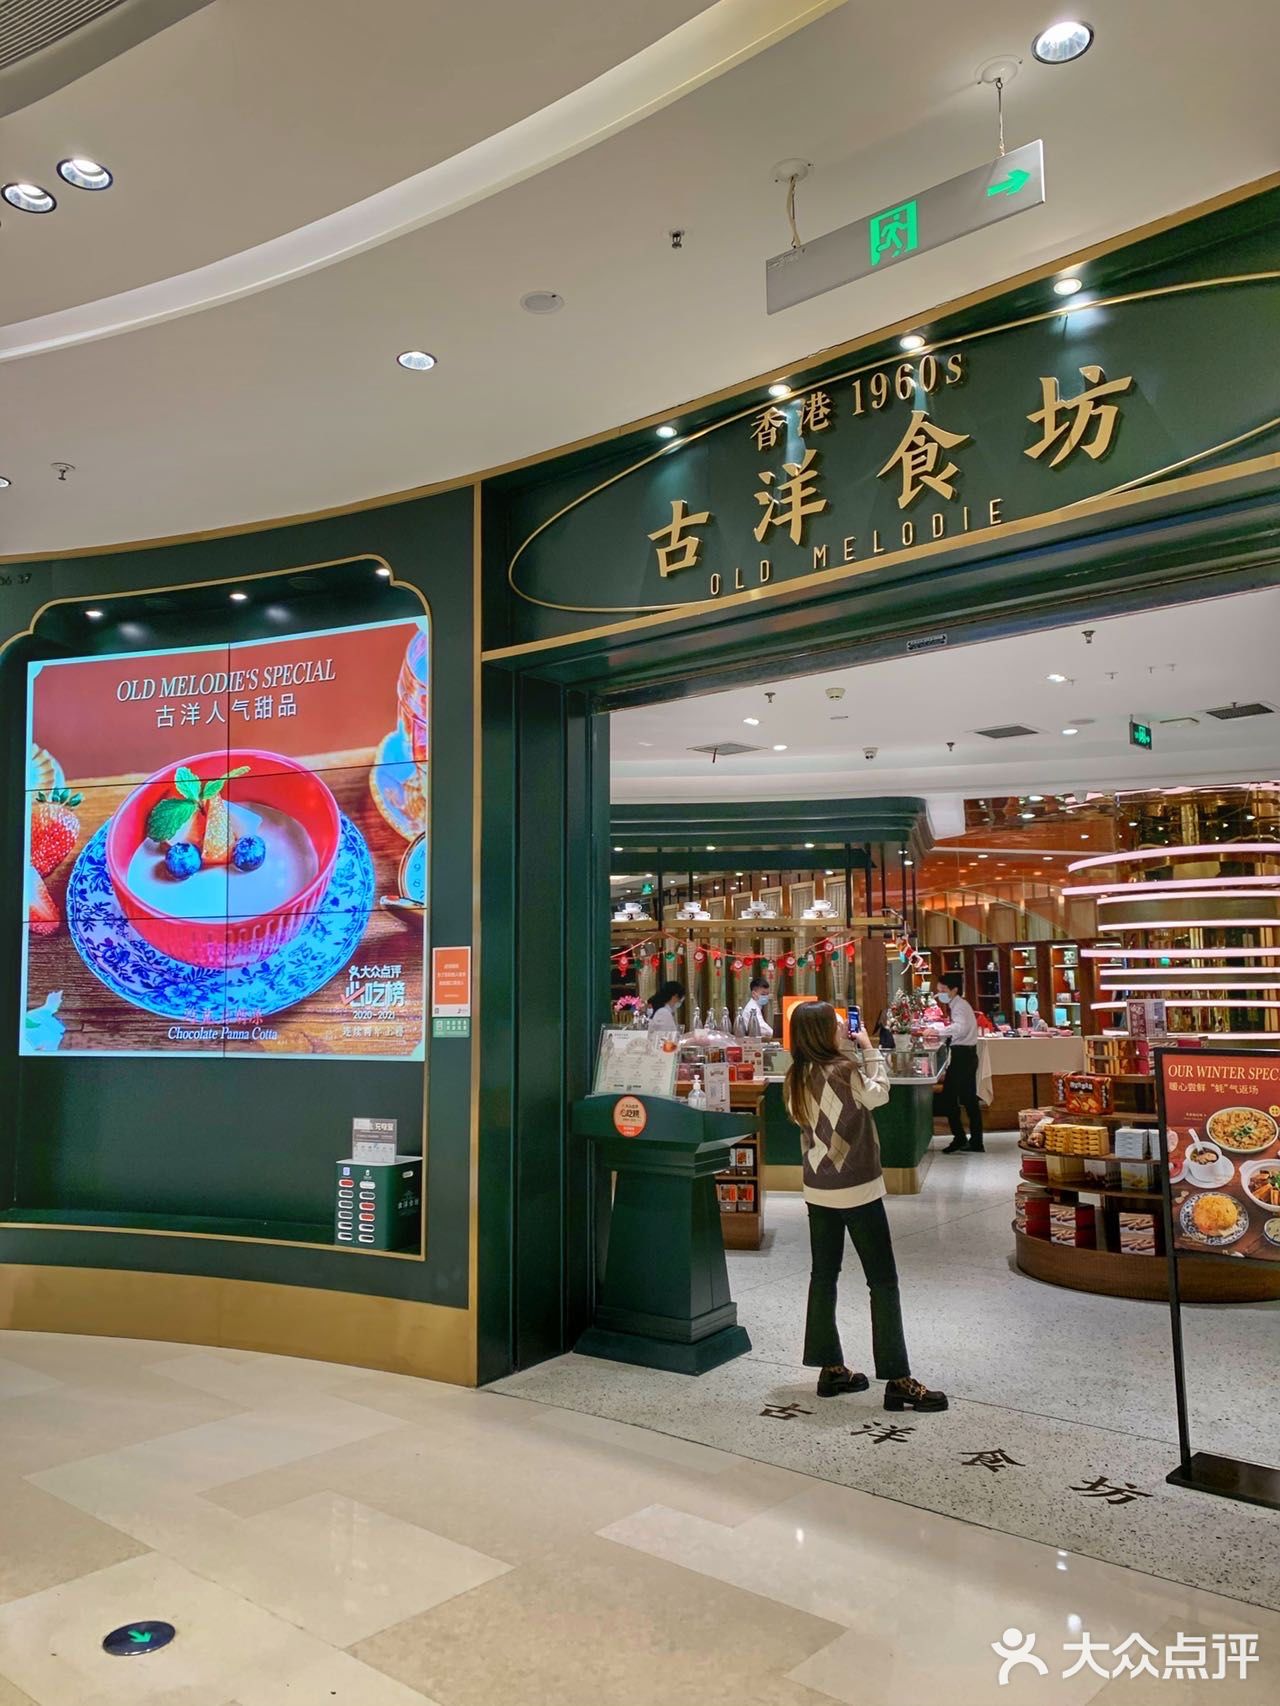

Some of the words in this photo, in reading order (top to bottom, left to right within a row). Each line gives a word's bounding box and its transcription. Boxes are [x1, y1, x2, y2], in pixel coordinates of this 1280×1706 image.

[749, 392, 832, 453] 香港
[852, 352, 966, 417] 1960s
[648, 364, 1134, 579] 古洋食坊
[710, 559, 772, 596] OLD
[813, 498, 1003, 570] MELODIE
[116, 678, 156, 702] OLD
[262, 658, 337, 689] SPECIAL
[155, 692, 297, 729] 古洋人气甜品
[360, 964, 402, 979] 大众点评
[167, 1026, 219, 1040] Chocolate
[220, 1026, 250, 1040] Panna
[251, 1026, 279, 1040] Cotta
[1168, 1064, 1194, 1078] OUR
[1196, 1065, 1246, 1080] WINTER
[1248, 1067, 1280, 1081] SPEC
[759, 1402, 1154, 1505] 古洋食坊
